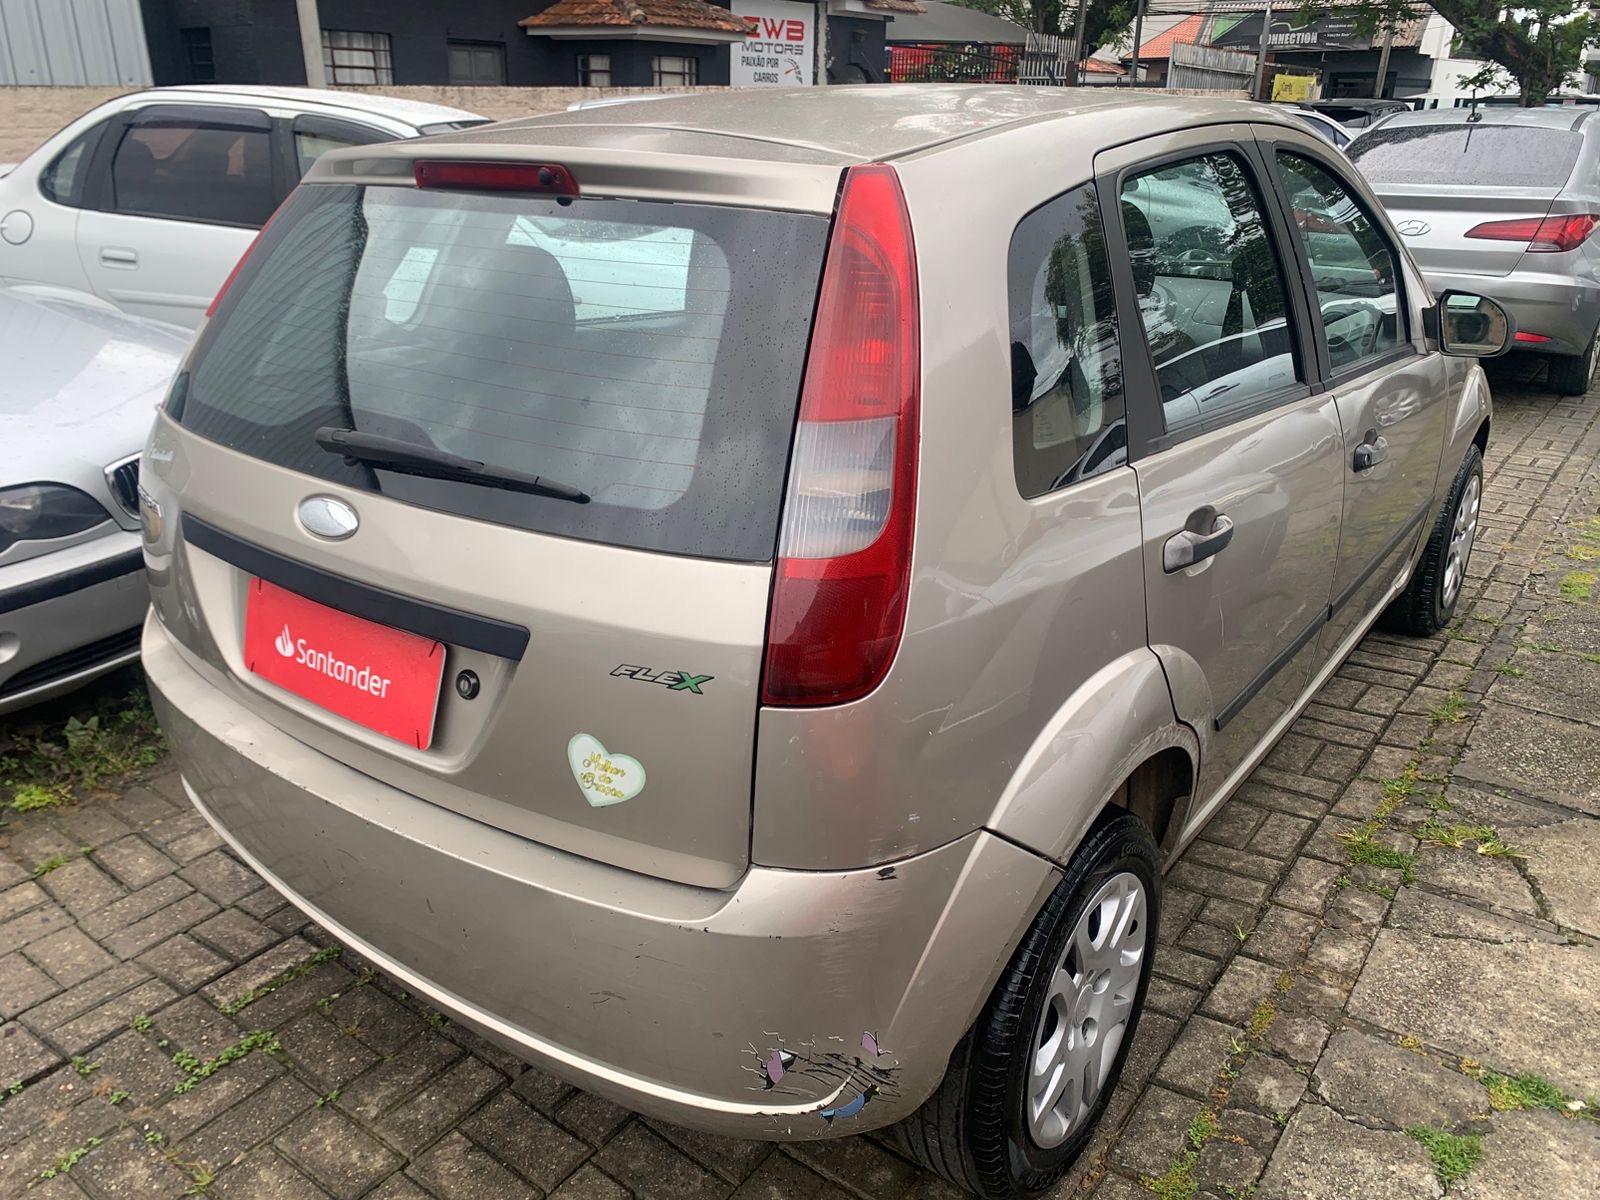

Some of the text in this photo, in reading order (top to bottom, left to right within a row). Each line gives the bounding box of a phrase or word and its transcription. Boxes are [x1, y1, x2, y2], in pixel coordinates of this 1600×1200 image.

[741, 41, 804, 55] MOTORS
[766, 57, 779, 68] POR
[753, 71, 779, 83] CARROS
[296, 638, 391, 698] Santander
[609, 664, 715, 695] FLEX
